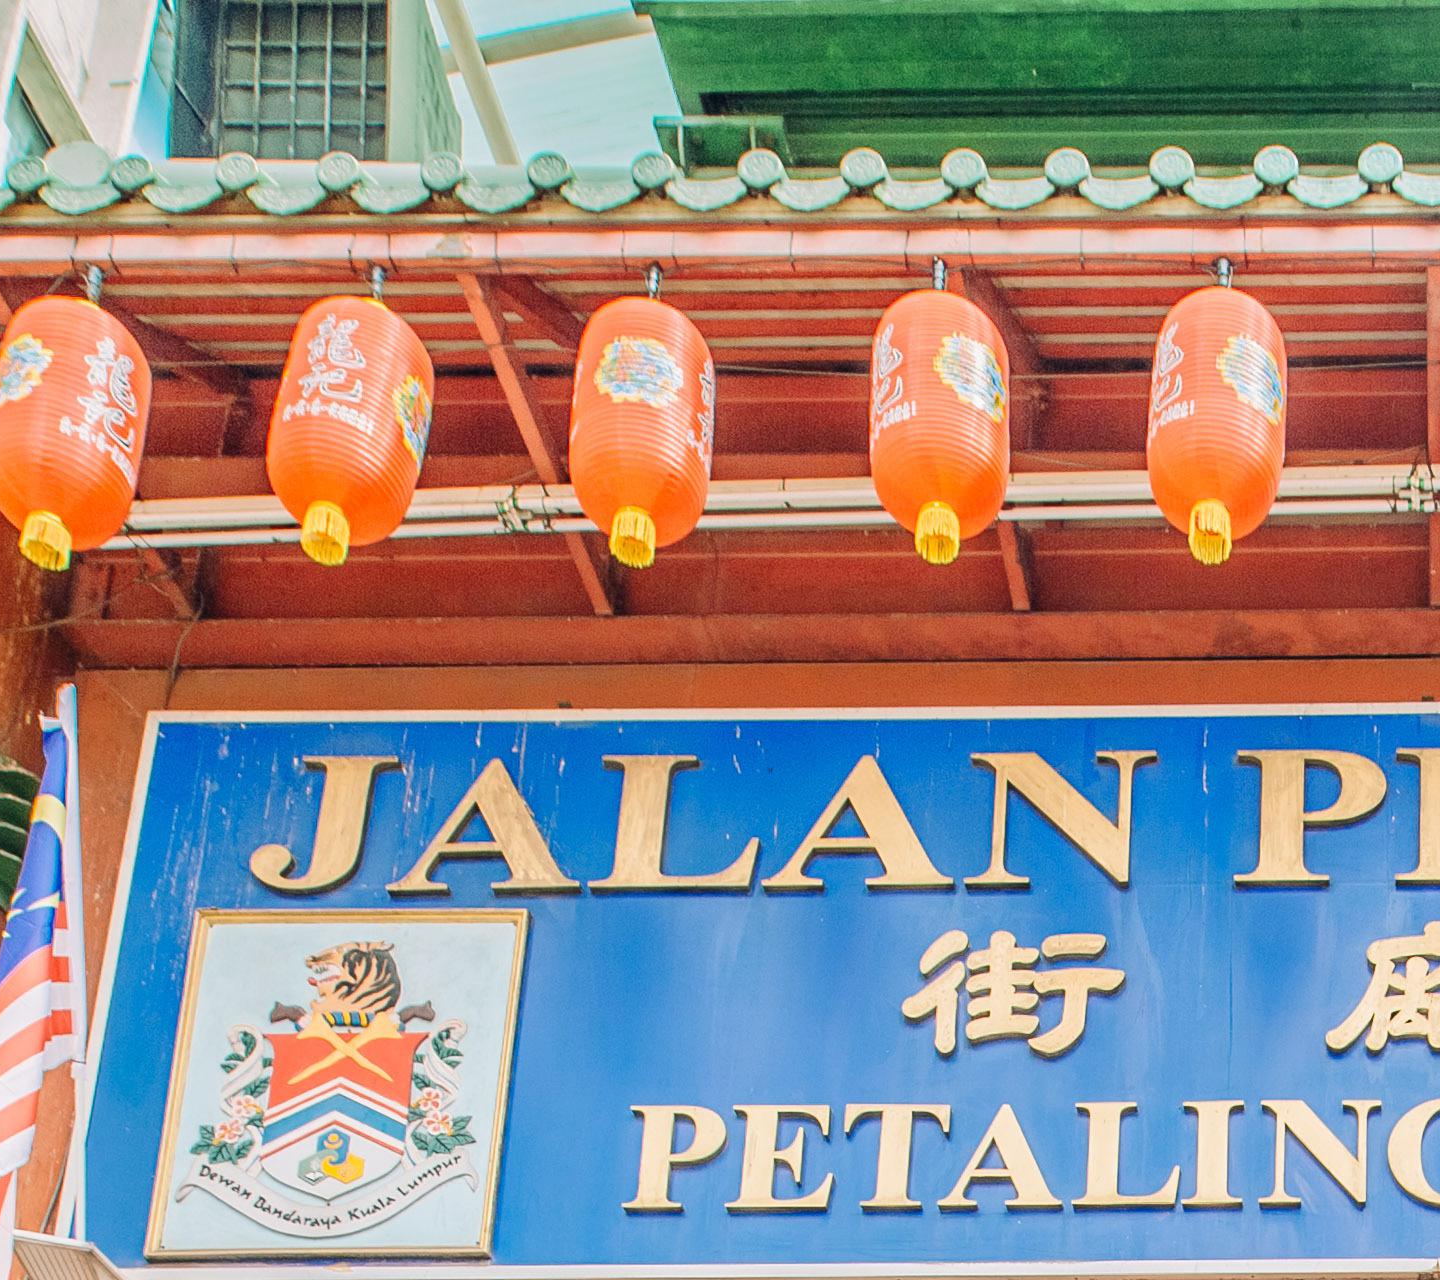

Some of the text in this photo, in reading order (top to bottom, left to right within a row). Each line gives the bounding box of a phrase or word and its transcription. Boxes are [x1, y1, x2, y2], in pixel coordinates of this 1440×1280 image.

[250, 751, 1157, 894] JALAN
[199, 1154, 462, 1230] Dewan Bandaraya Kuala Lumpur
